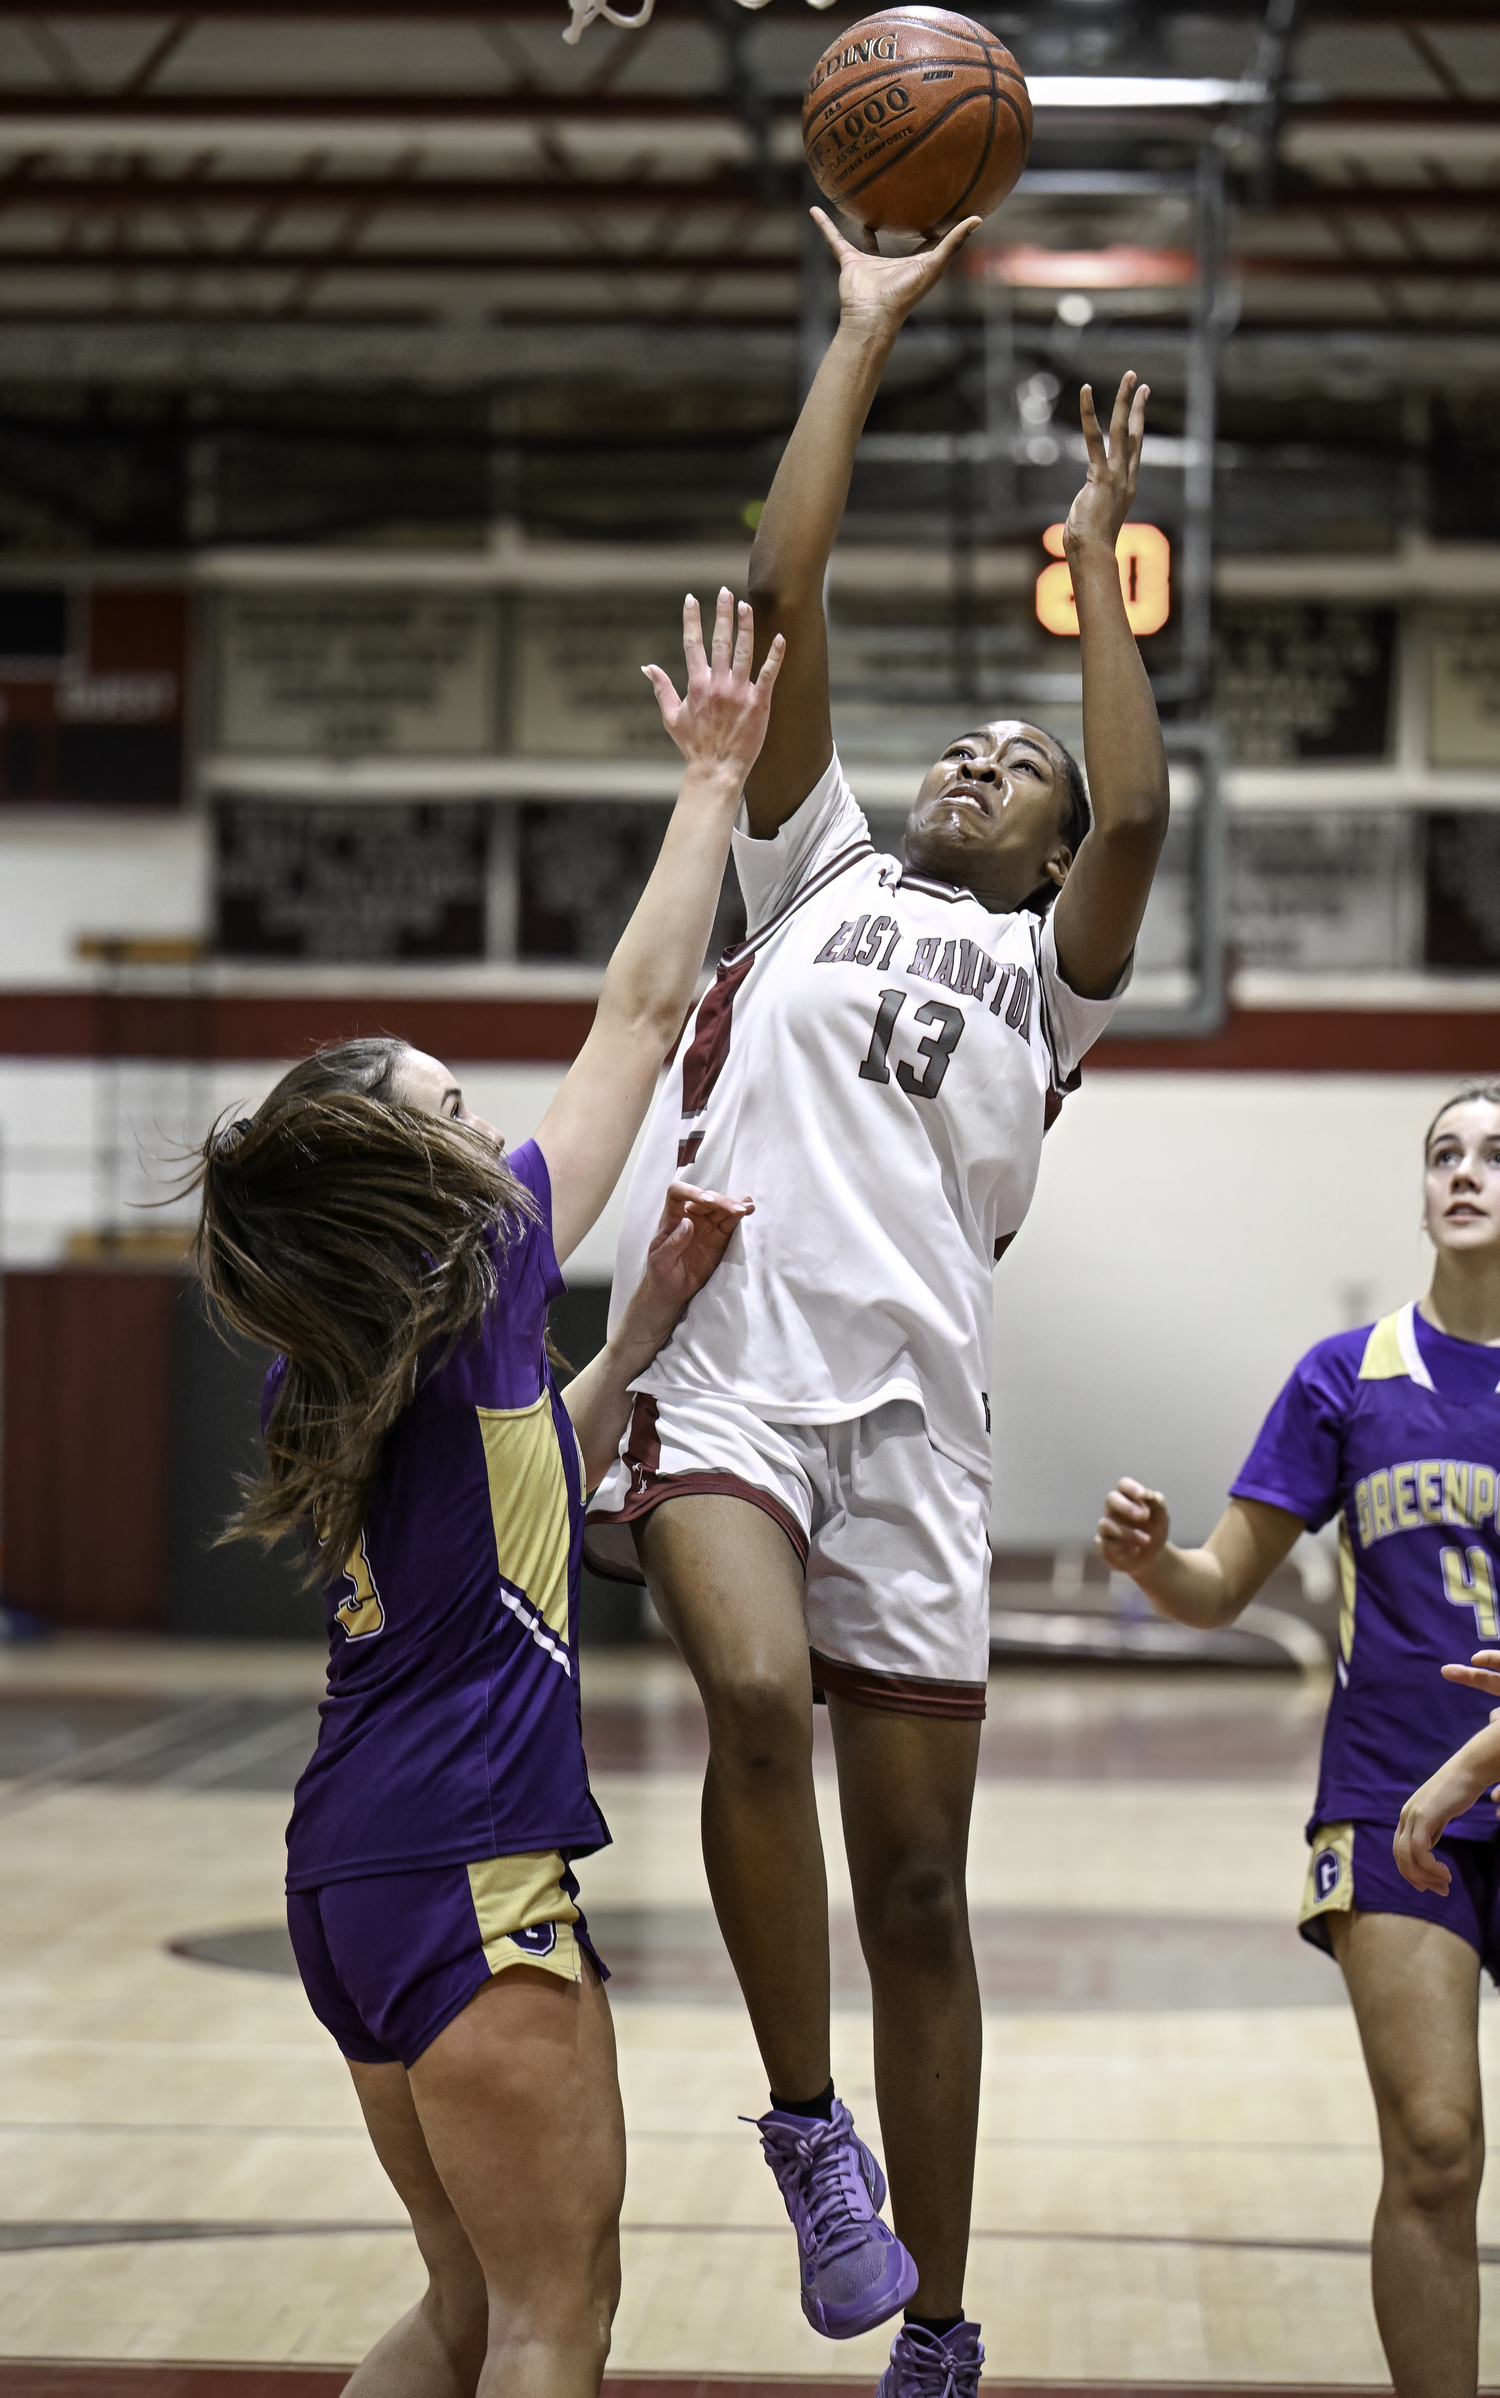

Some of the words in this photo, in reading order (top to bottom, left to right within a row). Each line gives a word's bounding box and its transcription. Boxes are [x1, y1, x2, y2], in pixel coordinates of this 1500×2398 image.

[863, 125, 915, 160] COMPOSITE
[813, 914, 901, 971] EAST
[858, 988, 966, 1100] 13
[1354, 1458, 1500, 1550] GREENP
[1439, 1545, 1500, 1641] 4
